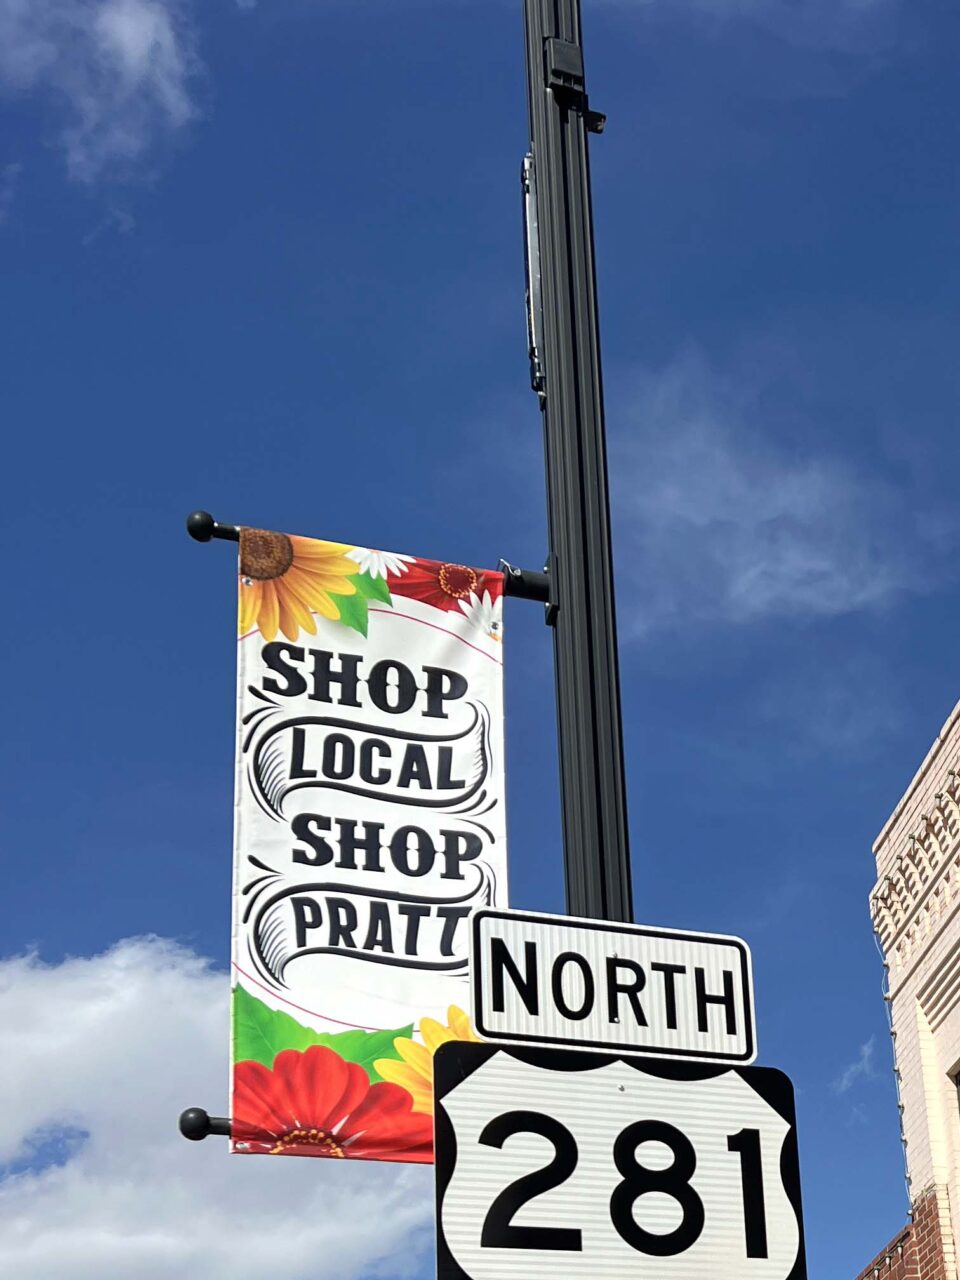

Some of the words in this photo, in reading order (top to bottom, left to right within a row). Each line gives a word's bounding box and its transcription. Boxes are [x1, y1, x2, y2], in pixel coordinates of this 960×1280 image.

[261, 641, 468, 719] SHOP
[289, 727, 466, 789] LOCAL
[291, 812, 483, 880] SHOP
[290, 896, 472, 957] PRATT
[490, 937, 737, 1036] NORTH
[478, 1110, 769, 1259] 281
